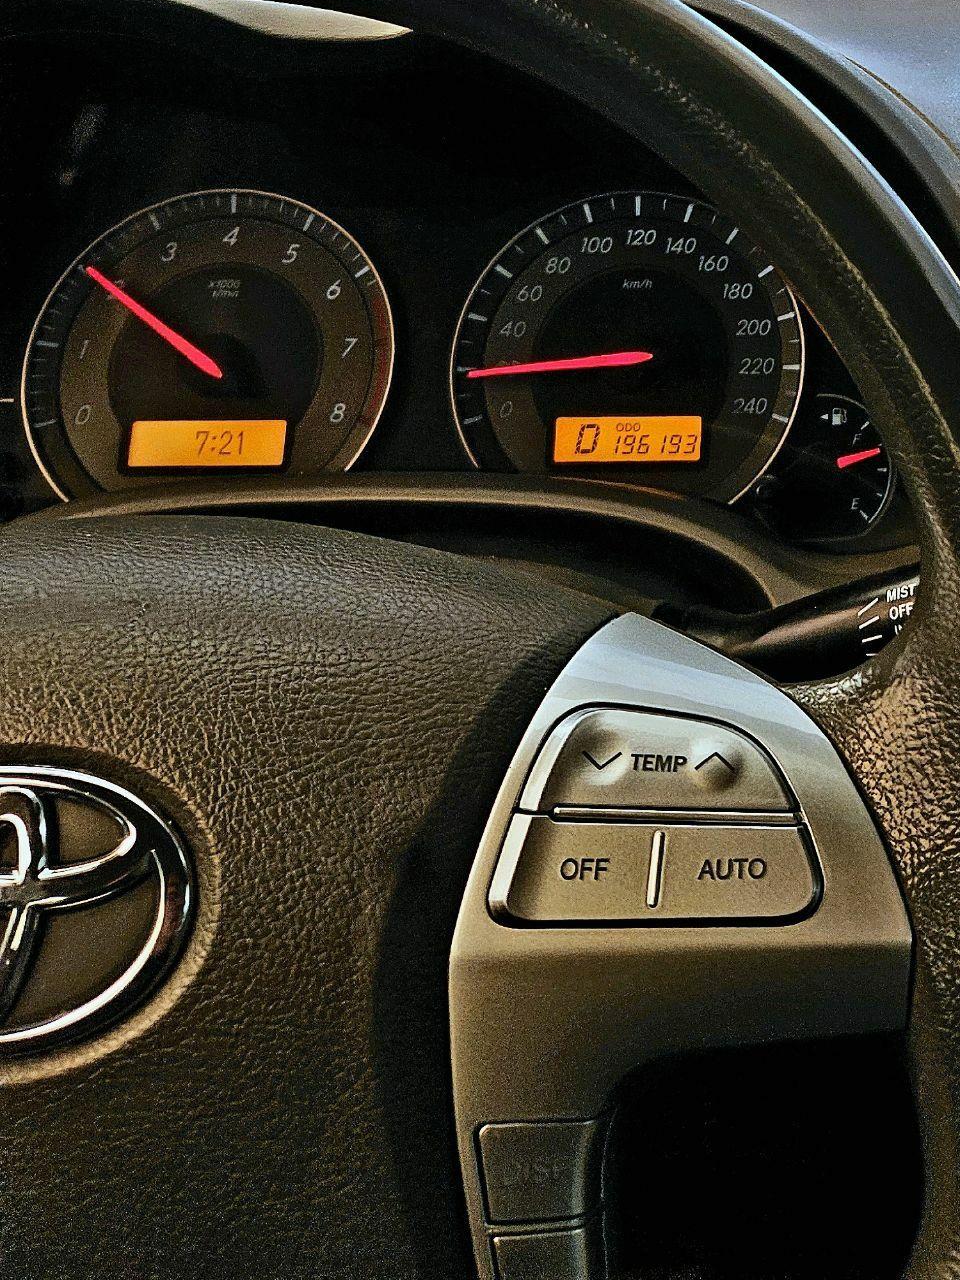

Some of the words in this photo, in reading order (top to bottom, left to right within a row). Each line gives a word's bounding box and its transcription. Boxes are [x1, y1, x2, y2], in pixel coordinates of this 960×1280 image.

[222, 226, 239, 246] 4
[581, 236, 614, 255] 100
[626, 229, 657, 247] 120
[161, 242, 178, 262] 3
[282, 243, 301, 264] 5
[665, 236, 697, 256] 140
[545, 256, 571, 275] 80
[698, 255, 729, 274] 160
[326, 280, 342, 301] 6
[517, 285, 543, 303] 60
[622, 279, 653, 290] km/h
[723, 282, 754, 301] 180
[500, 321, 526, 338] 40
[736, 319, 771, 336] 200
[78, 339, 90, 360] 1
[341, 337, 359, 359] 7
[738, 358, 775, 375] 220
[74, 404, 92, 425] 0
[329, 402, 347, 423] 8
[499, 399, 514, 418] 0
[733, 397, 768, 416] 240
[616, 422, 641, 432] ODO
[195, 430, 246, 456] 7:21
[614, 434, 698, 455] 196193
[850, 497, 861, 510] E
[886, 582, 918, 602] MIST
[889, 601, 915, 620] OFF
[630, 753, 688, 775] TEMP
[559, 858, 611, 882] OFF
[697, 858, 768, 882] AUTO
